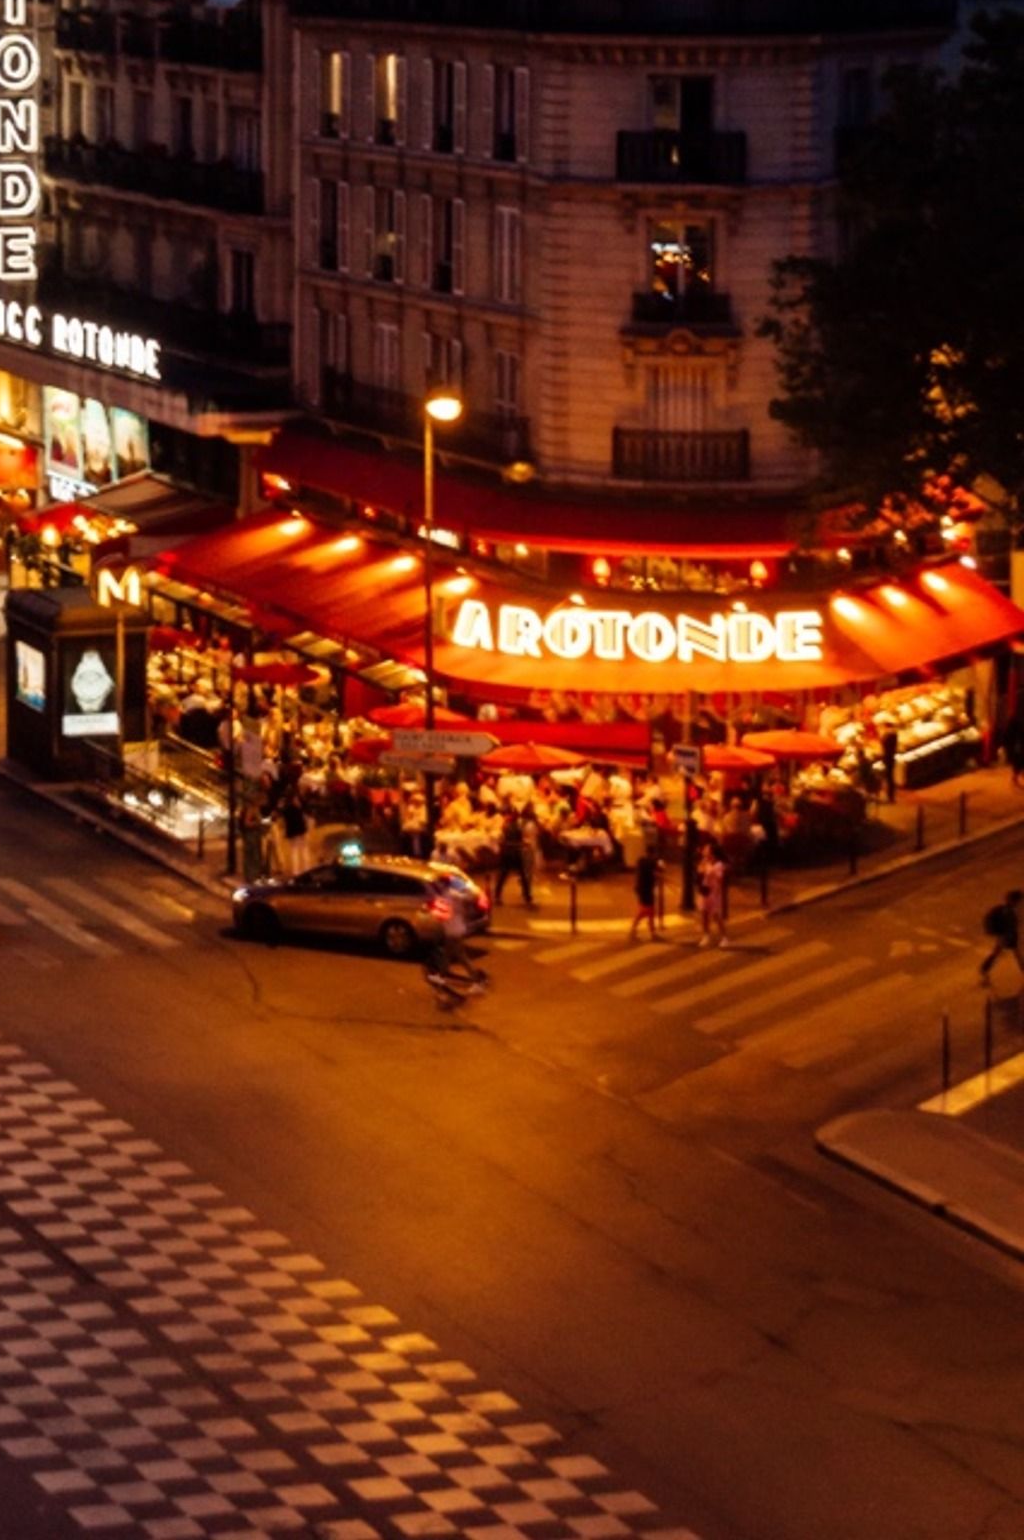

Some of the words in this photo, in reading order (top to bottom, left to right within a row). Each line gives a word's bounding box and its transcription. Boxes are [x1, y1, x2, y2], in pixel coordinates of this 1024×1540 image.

[51, 313, 162, 380] ROTONDE
[98, 566, 141, 608] M
[497, 604, 824, 662] ROTONDE
